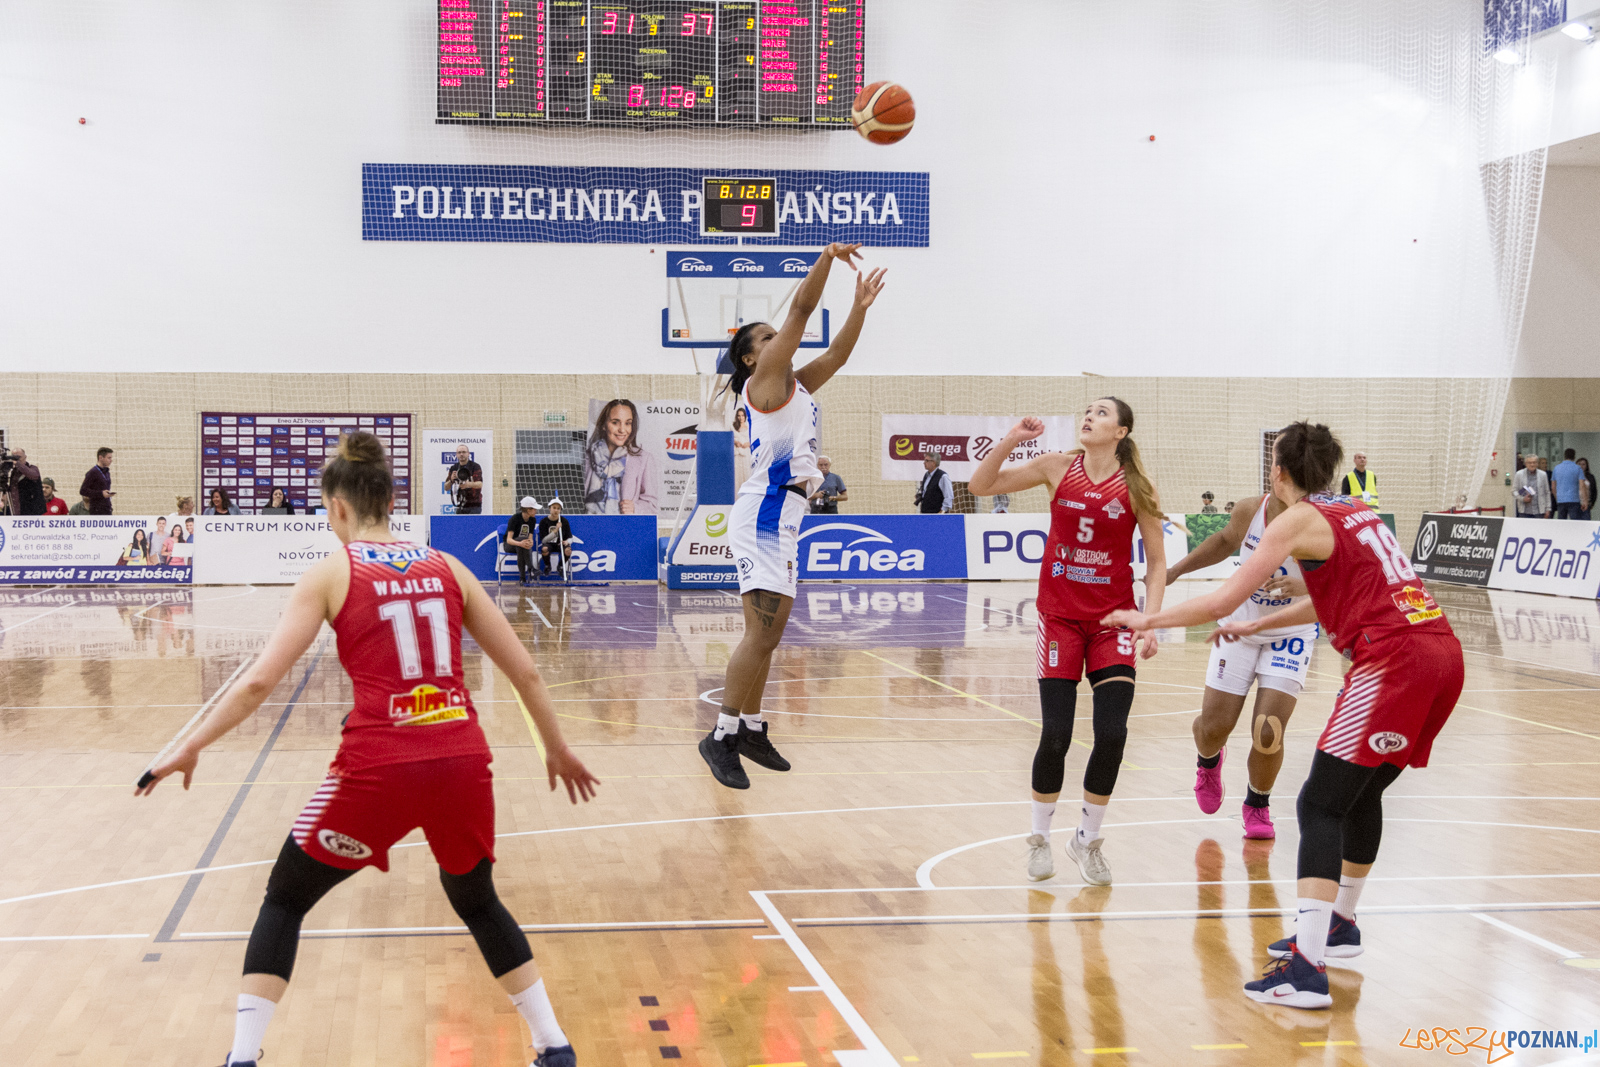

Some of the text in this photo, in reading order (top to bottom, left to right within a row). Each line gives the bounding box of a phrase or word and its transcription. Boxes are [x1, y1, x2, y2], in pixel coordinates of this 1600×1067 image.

[581, 16, 586, 26] 1
[601, 12, 634, 35] 31
[681, 13, 713, 36] 37
[746, 18, 755, 29] 3
[649, 24, 658, 36] 3
[577, 51, 585, 63] 2
[746, 55, 755, 65] 4
[592, 84, 601, 96] 2
[704, 86, 714, 98] 0
[392, 185, 665, 222] POLITECHNIKA
[741, 205, 757, 226] 9
[681, 263, 713, 272] Enea
[733, 263, 764, 272] Enea
[646, 406, 681, 414] SALON
[918, 442, 961, 456] Energa
[12, 518, 147, 529] ZESPÓŁ SZKÓŁ BUDOWLANYCH
[205, 522, 278, 532] CENTRUM
[1076, 516, 1095, 543] 5
[11, 533, 20, 541] ul.
[22, 533, 70, 541] Grunwaldzka
[91, 533, 118, 541] Poznań
[10, 552, 100, 562] sekretariat@zsb.com.pl
[361, 547, 429, 562] Lazur
[807, 542, 925, 572] Enea
[1076, 548, 1109, 560] OSTRÓW
[1356, 522, 1417, 585] 18
[1436, 541, 1495, 561] KTÓRE SIĘ CZYTA
[23, 567, 75, 580] zawód
[77, 570, 87, 579] z
[90, 567, 191, 582] przyszłością!
[1066, 564, 1096, 575] POWIAT
[1433, 566, 1487, 579] www.rebis.com.pl
[1066, 573, 1111, 584] OSTROWSKI
[373, 577, 444, 596] WAJLER
[378, 598, 453, 680] 11
[1117, 632, 1133, 656] 5
